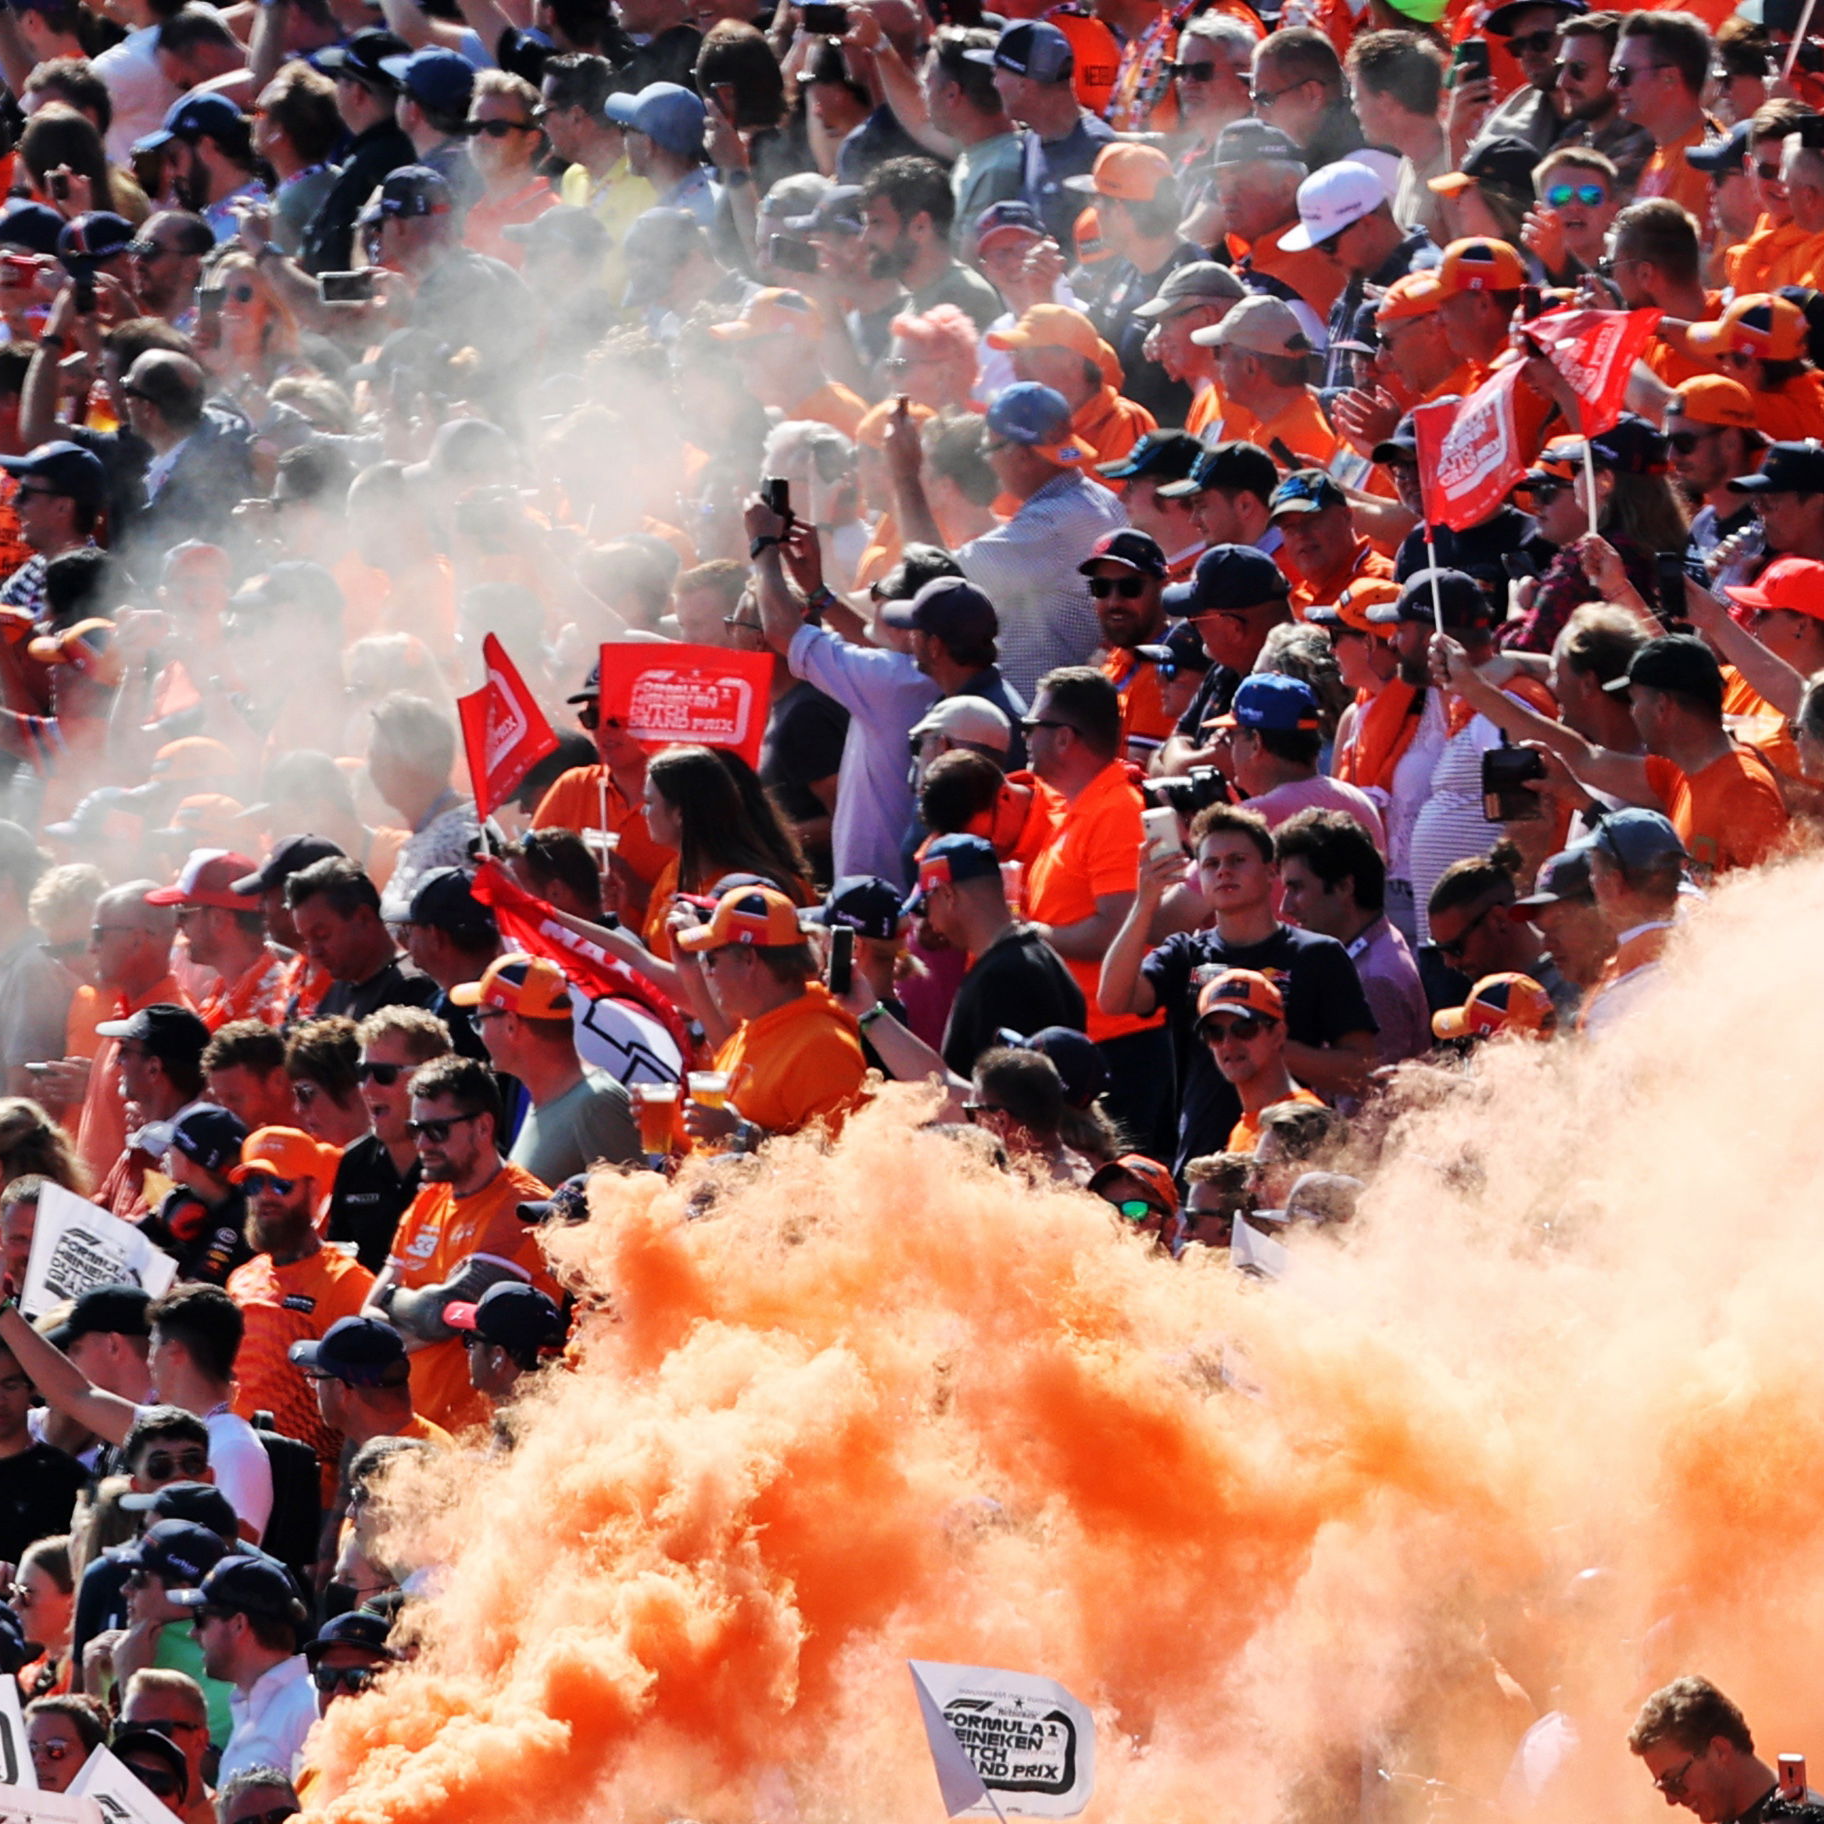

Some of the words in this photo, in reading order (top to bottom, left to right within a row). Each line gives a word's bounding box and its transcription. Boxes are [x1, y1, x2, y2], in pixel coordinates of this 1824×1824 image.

[951, 1727, 1042, 1750] EINEKEN
[1048, 1726, 1058, 1736] 1
[1013, 1764, 1058, 1779] PRIX
